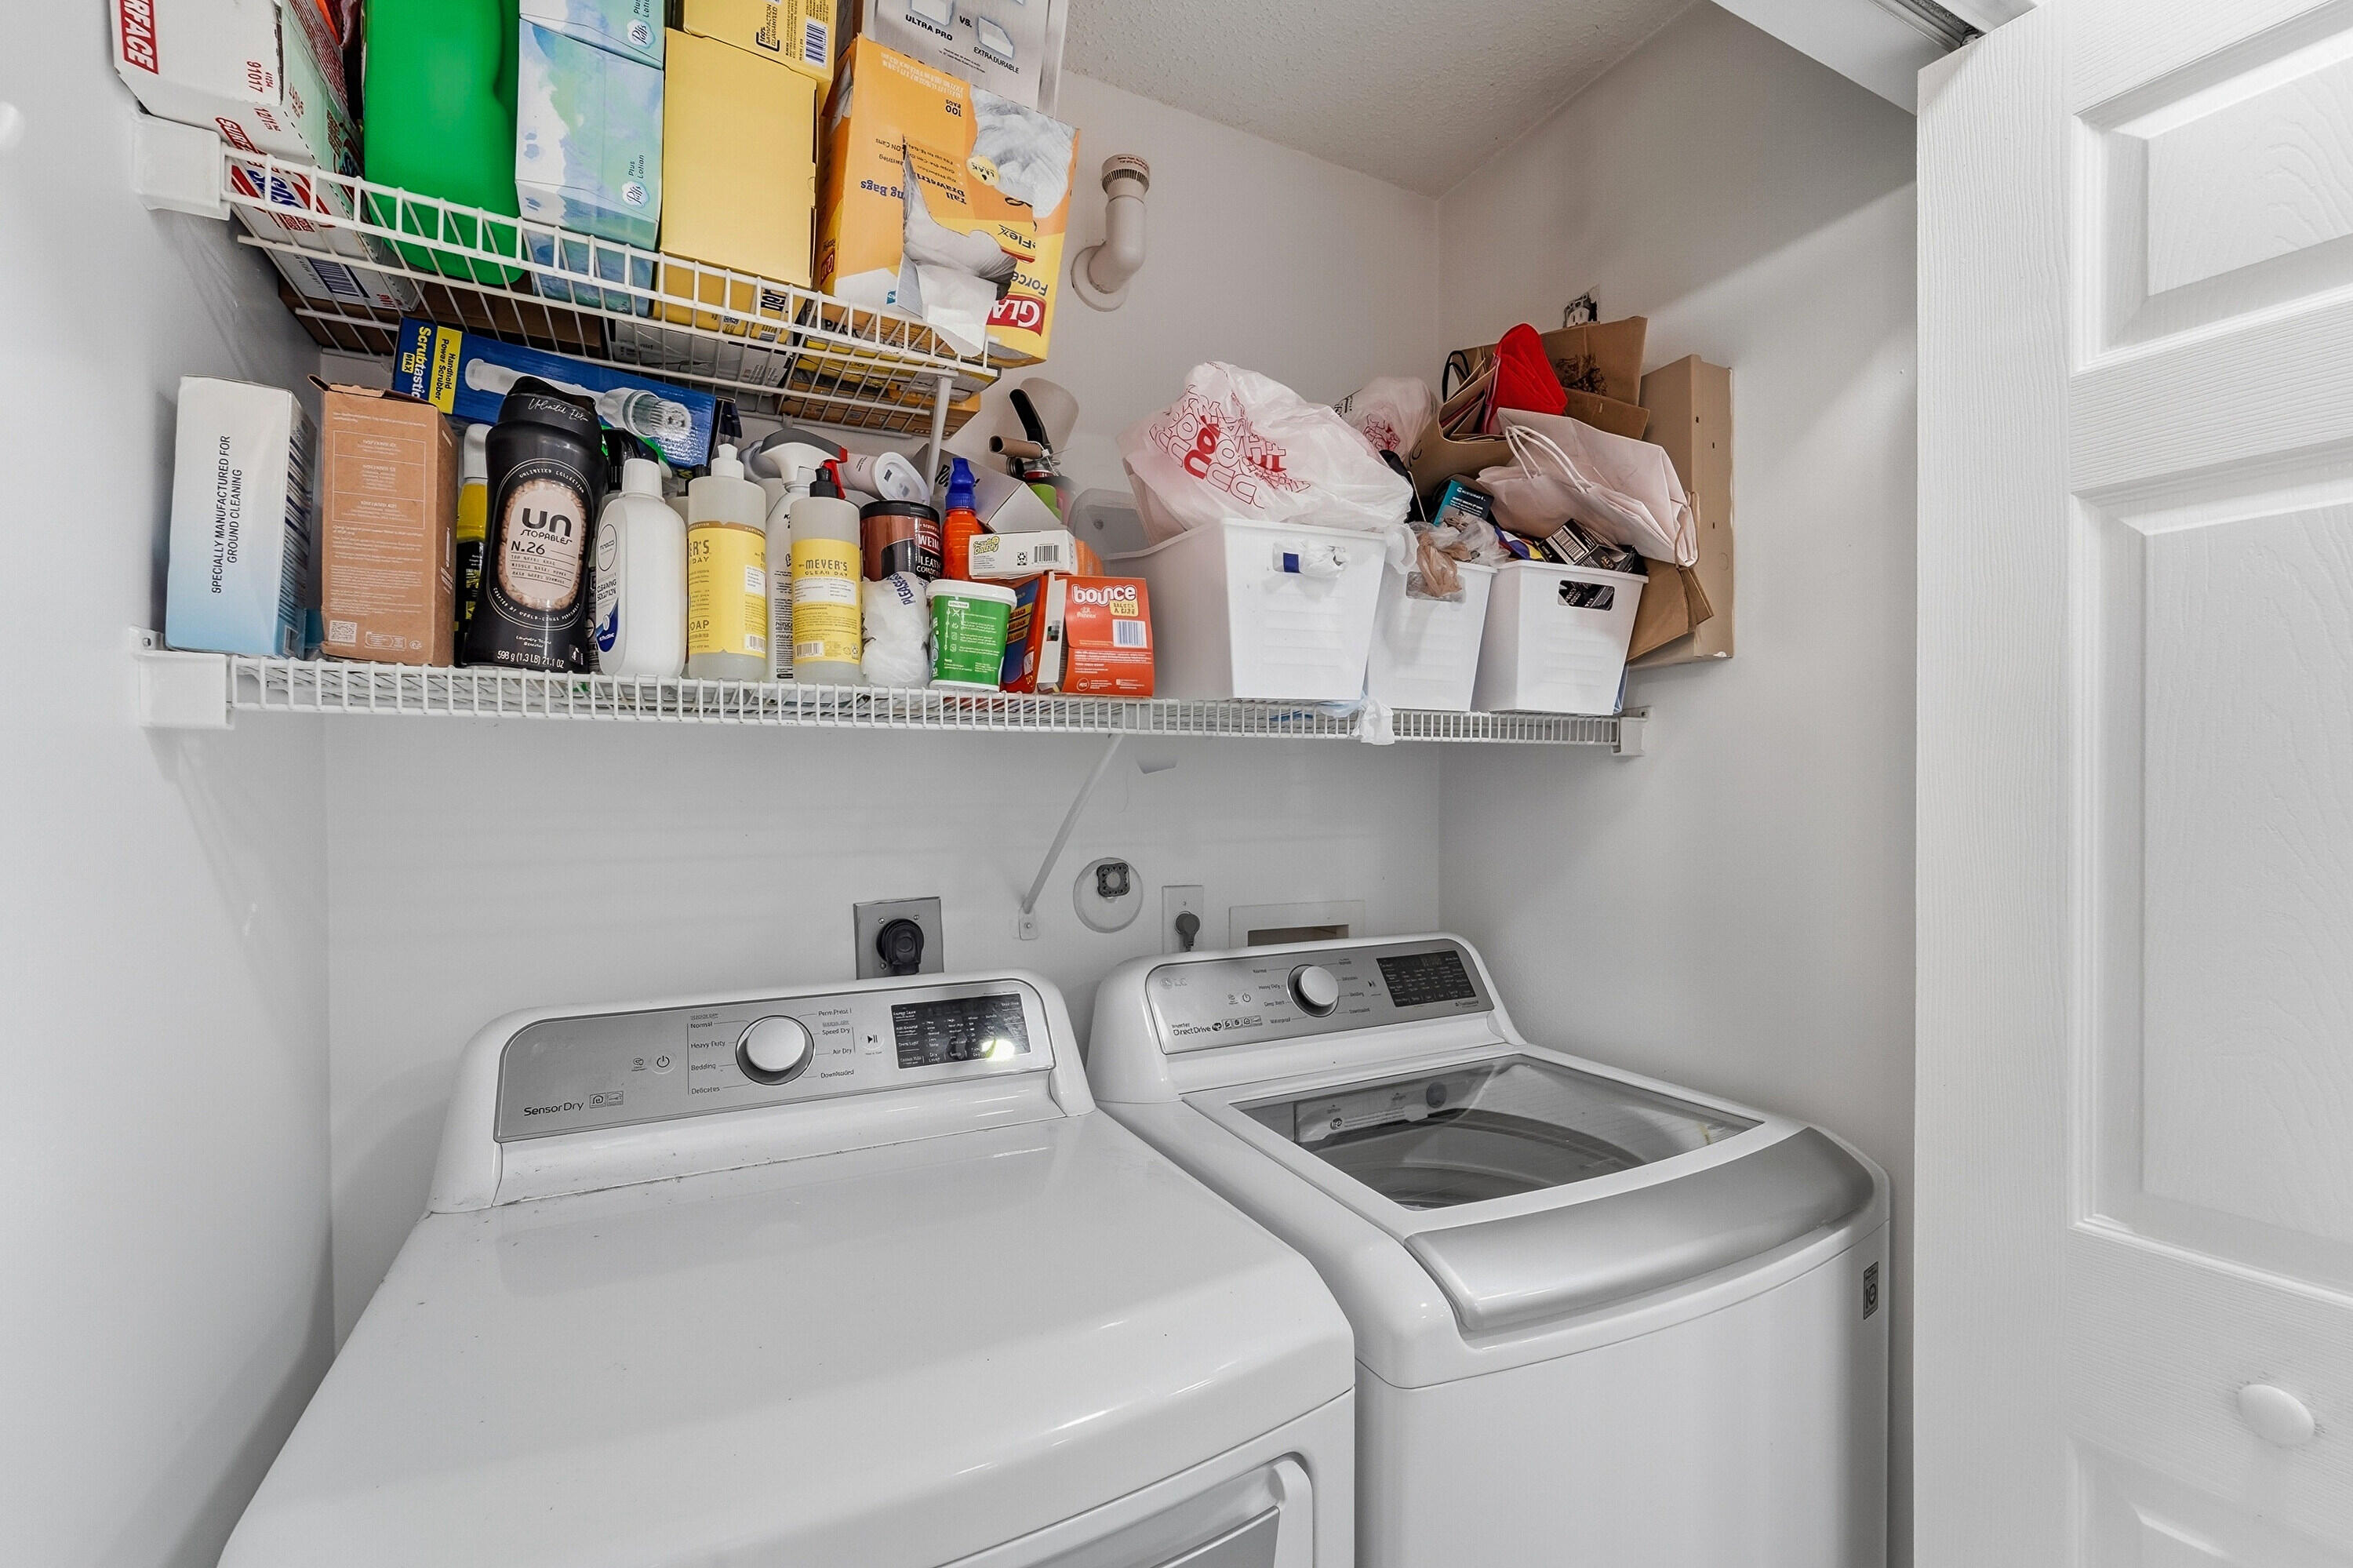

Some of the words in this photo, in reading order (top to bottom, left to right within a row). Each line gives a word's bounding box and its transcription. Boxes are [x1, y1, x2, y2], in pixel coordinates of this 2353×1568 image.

[906, 14, 933, 32] ULTRA
[935, 28, 952, 41] PRO
[247, 61, 264, 93] 91017
[945, 105, 962, 117] 100
[860, 180, 887, 196] Bags
[998, 224, 1036, 249] Flex
[992, 300, 1040, 329] GLA
[404, 353, 413, 372] MAX
[221, 435, 231, 456] FOR
[215, 458, 229, 540] MANUFACTURED
[231, 469, 242, 518] CLEANING
[227, 522, 238, 563] GROUND
[511, 540, 545, 555] N.26
[211, 540, 224, 594] SPECIALLY
[1072, 584, 1136, 606] bounce
[690, 620, 709, 631] OAP
[691, 1063, 716, 1071] Bedding
